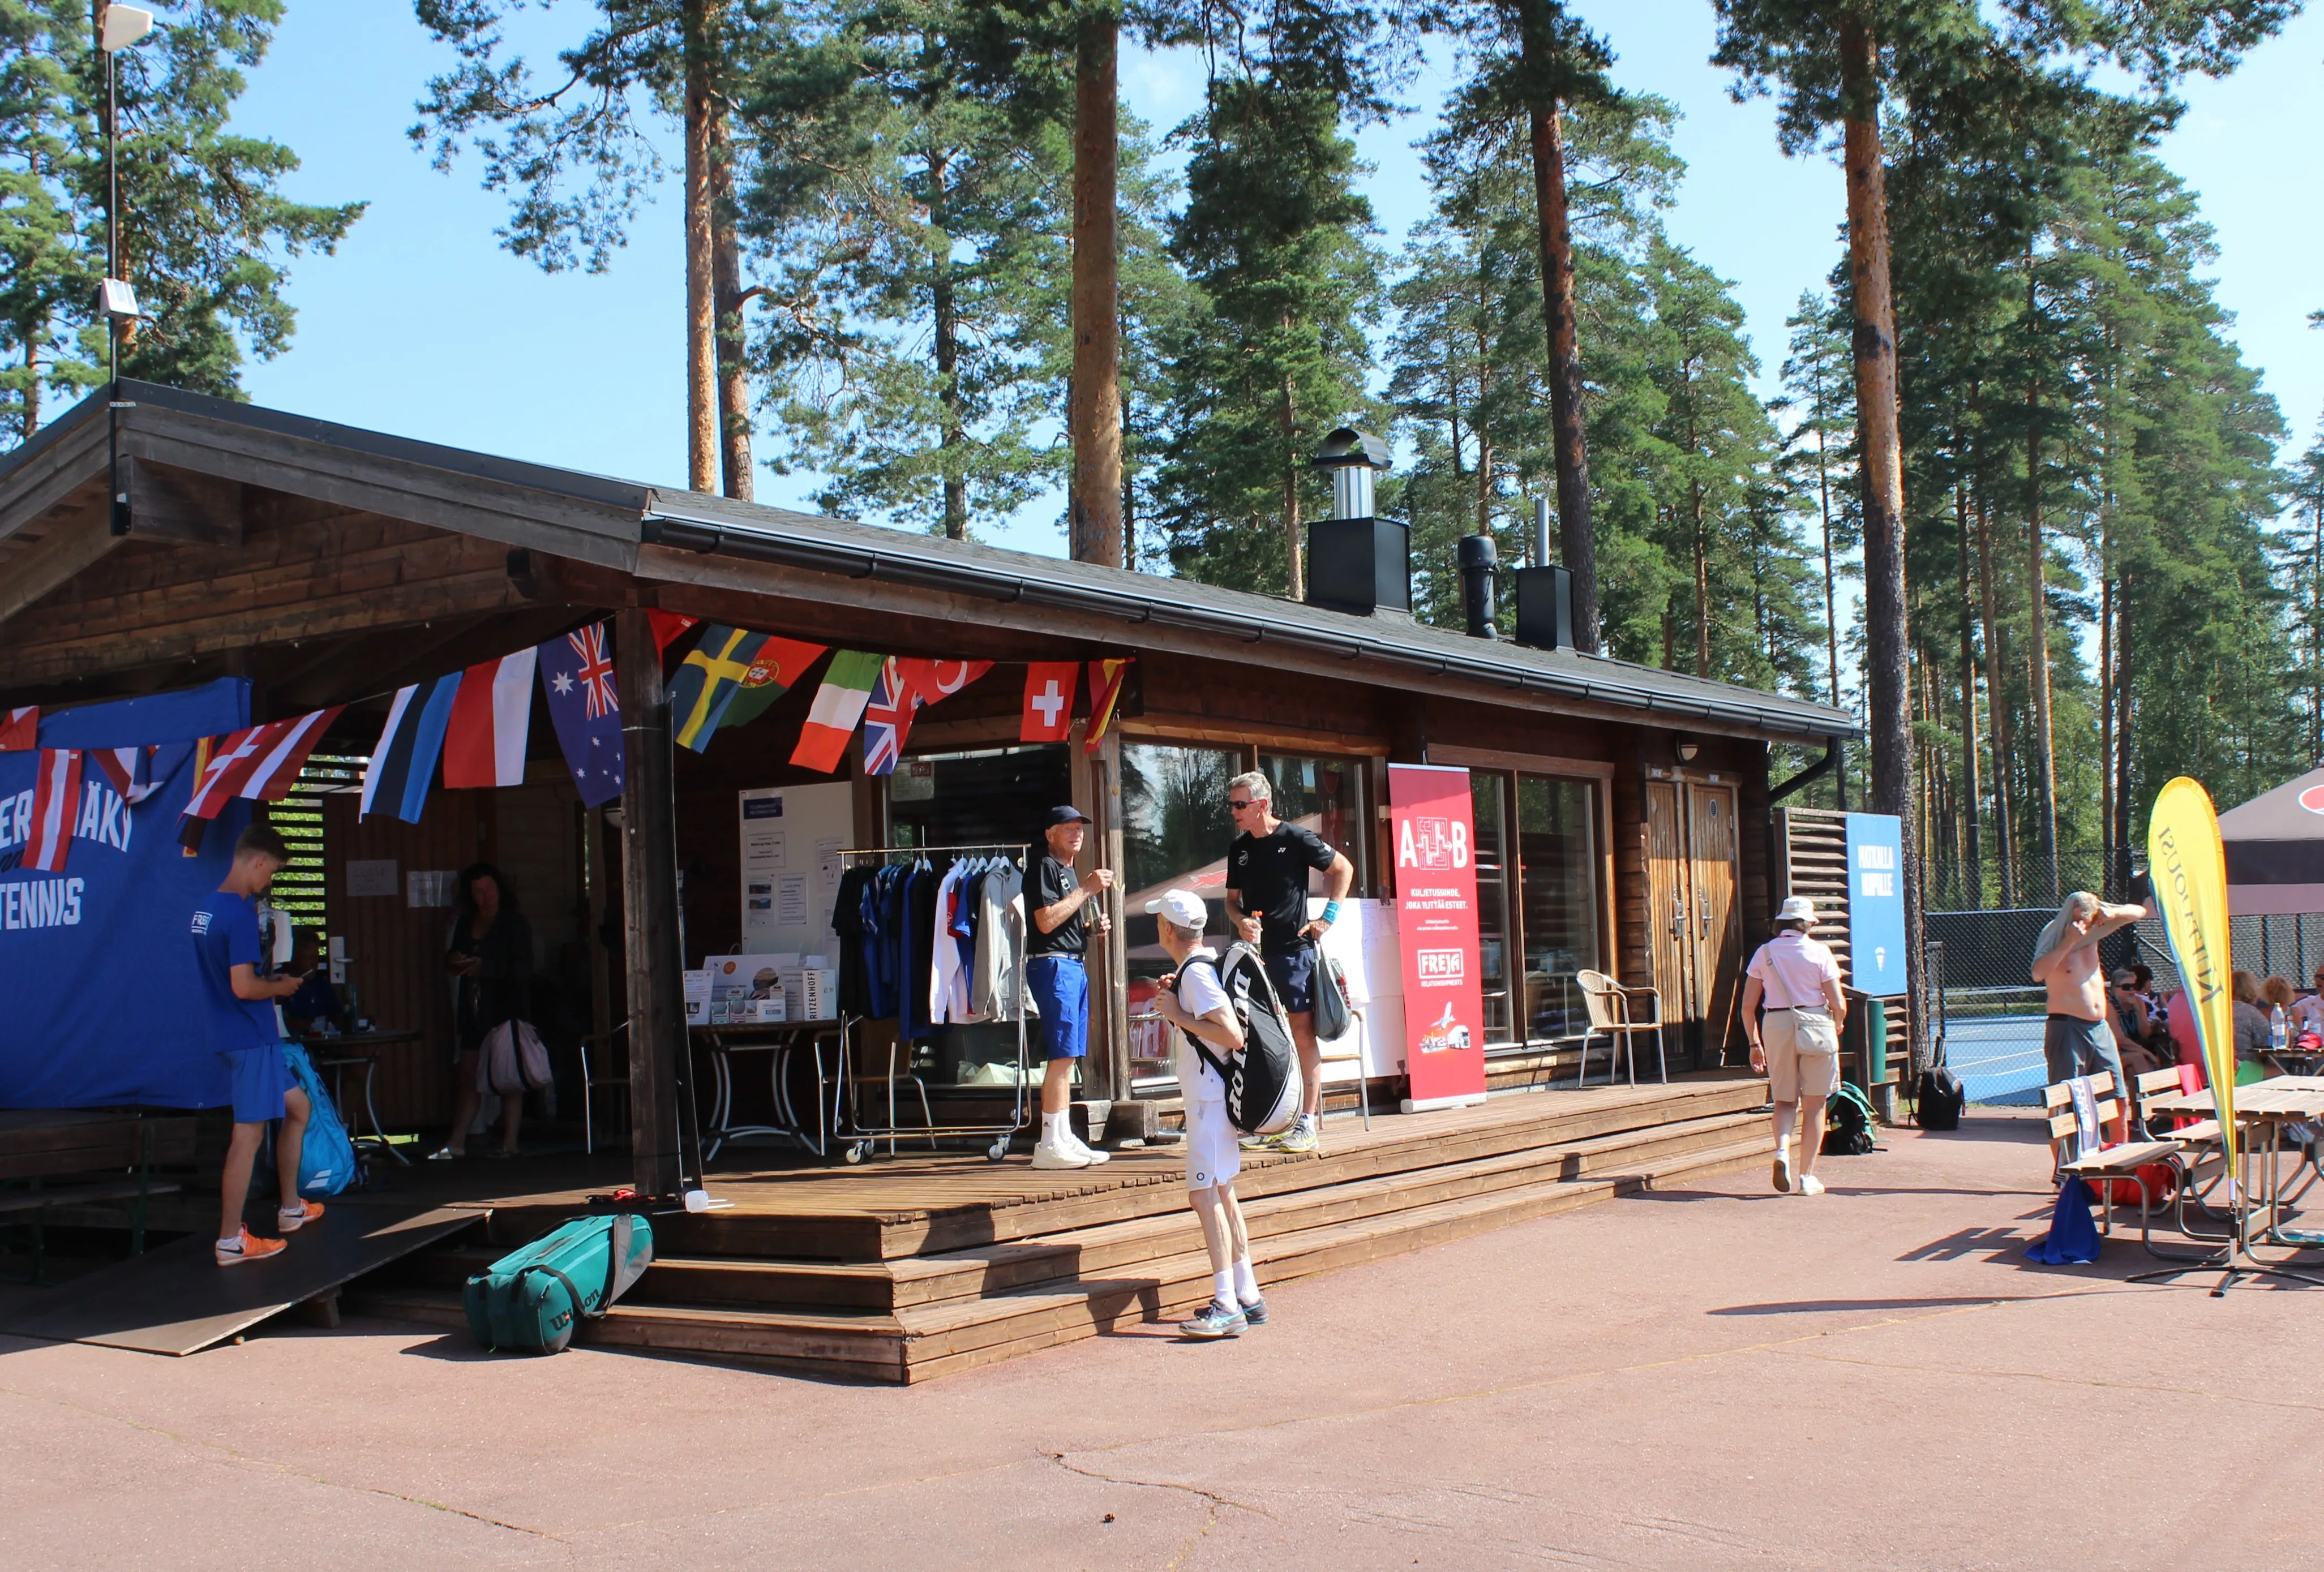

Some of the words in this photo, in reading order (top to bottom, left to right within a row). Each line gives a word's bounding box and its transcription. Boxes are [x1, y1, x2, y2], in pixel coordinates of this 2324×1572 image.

[1399, 820, 1418, 867] A
[1451, 821, 1468, 868] B
[1405, 901, 1421, 909] JOKA
[1421, 953, 1460, 974] FREJA
[808, 972, 817, 1019] RITZENHOFF
[549, 1288, 600, 1332] Wion
